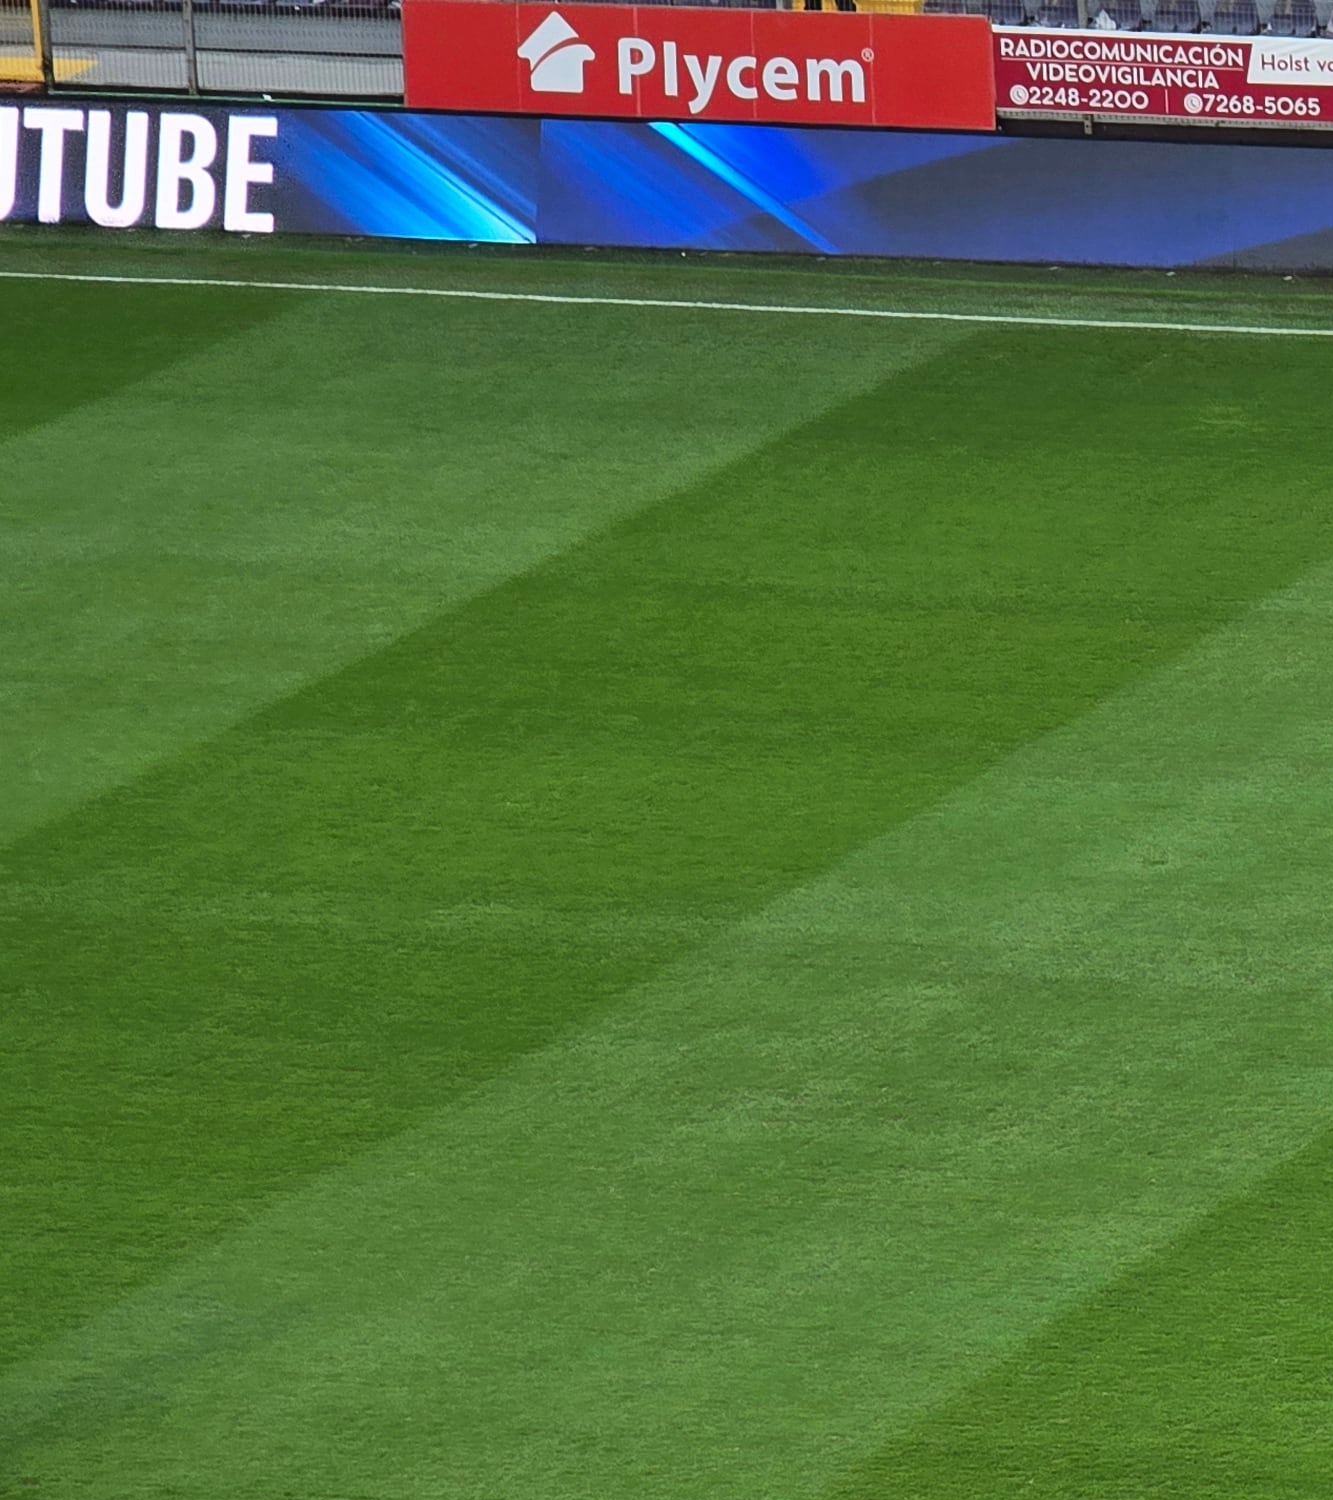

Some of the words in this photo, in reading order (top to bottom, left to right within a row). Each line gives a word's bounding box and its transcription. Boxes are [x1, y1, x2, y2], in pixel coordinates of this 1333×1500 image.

[1000, 38, 1244, 66] RADIOCOMUNICACIÓN
[1261, 53, 1310, 72] Holst
[617, 37, 866, 114] Plycem
[1026, 62, 1219, 89] VIDEOVIGILANCIA
[1029, 87, 1149, 110] 2248-2200
[1203, 94, 1320, 116] 7268-5065
[0, 107, 278, 233] TUBE
